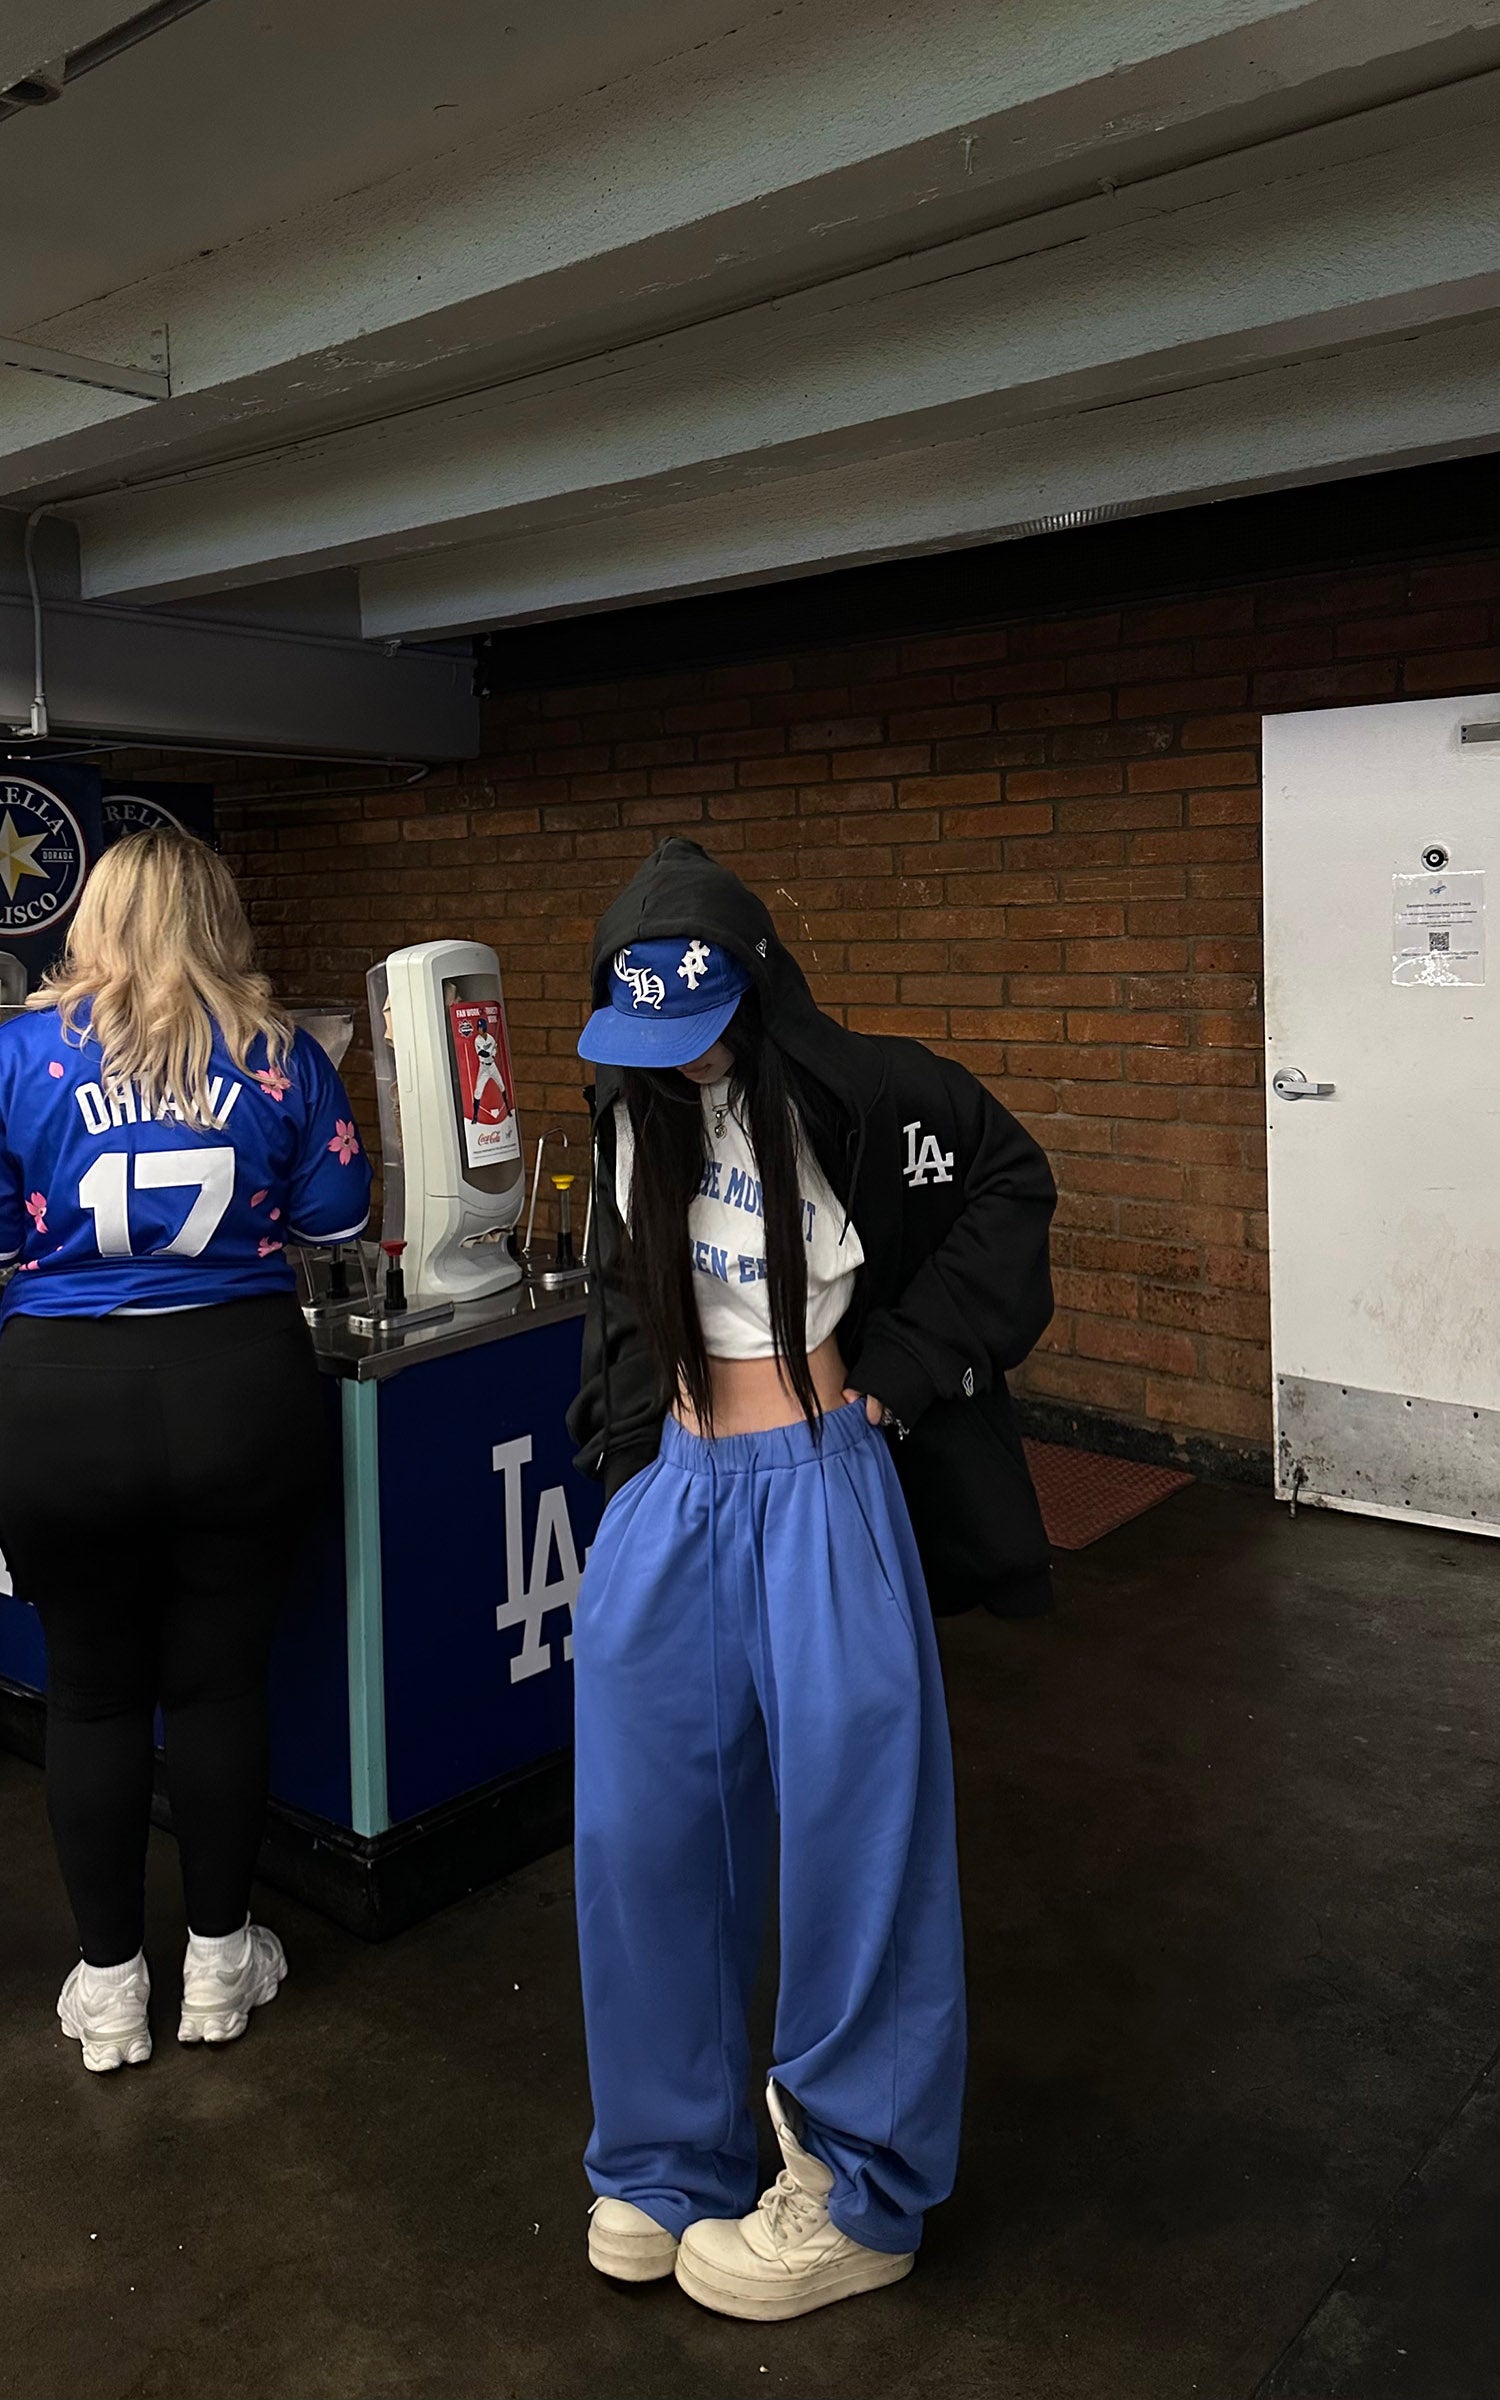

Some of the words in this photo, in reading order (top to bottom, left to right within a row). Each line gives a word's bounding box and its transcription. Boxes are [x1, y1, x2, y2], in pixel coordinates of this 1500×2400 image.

[0, 786, 65, 836] ELLA
[0, 892, 57, 924] ISCO
[903, 1121, 954, 1187] LA
[79, 1147, 235, 1258] 17
[492, 1434, 592, 1684] LA
